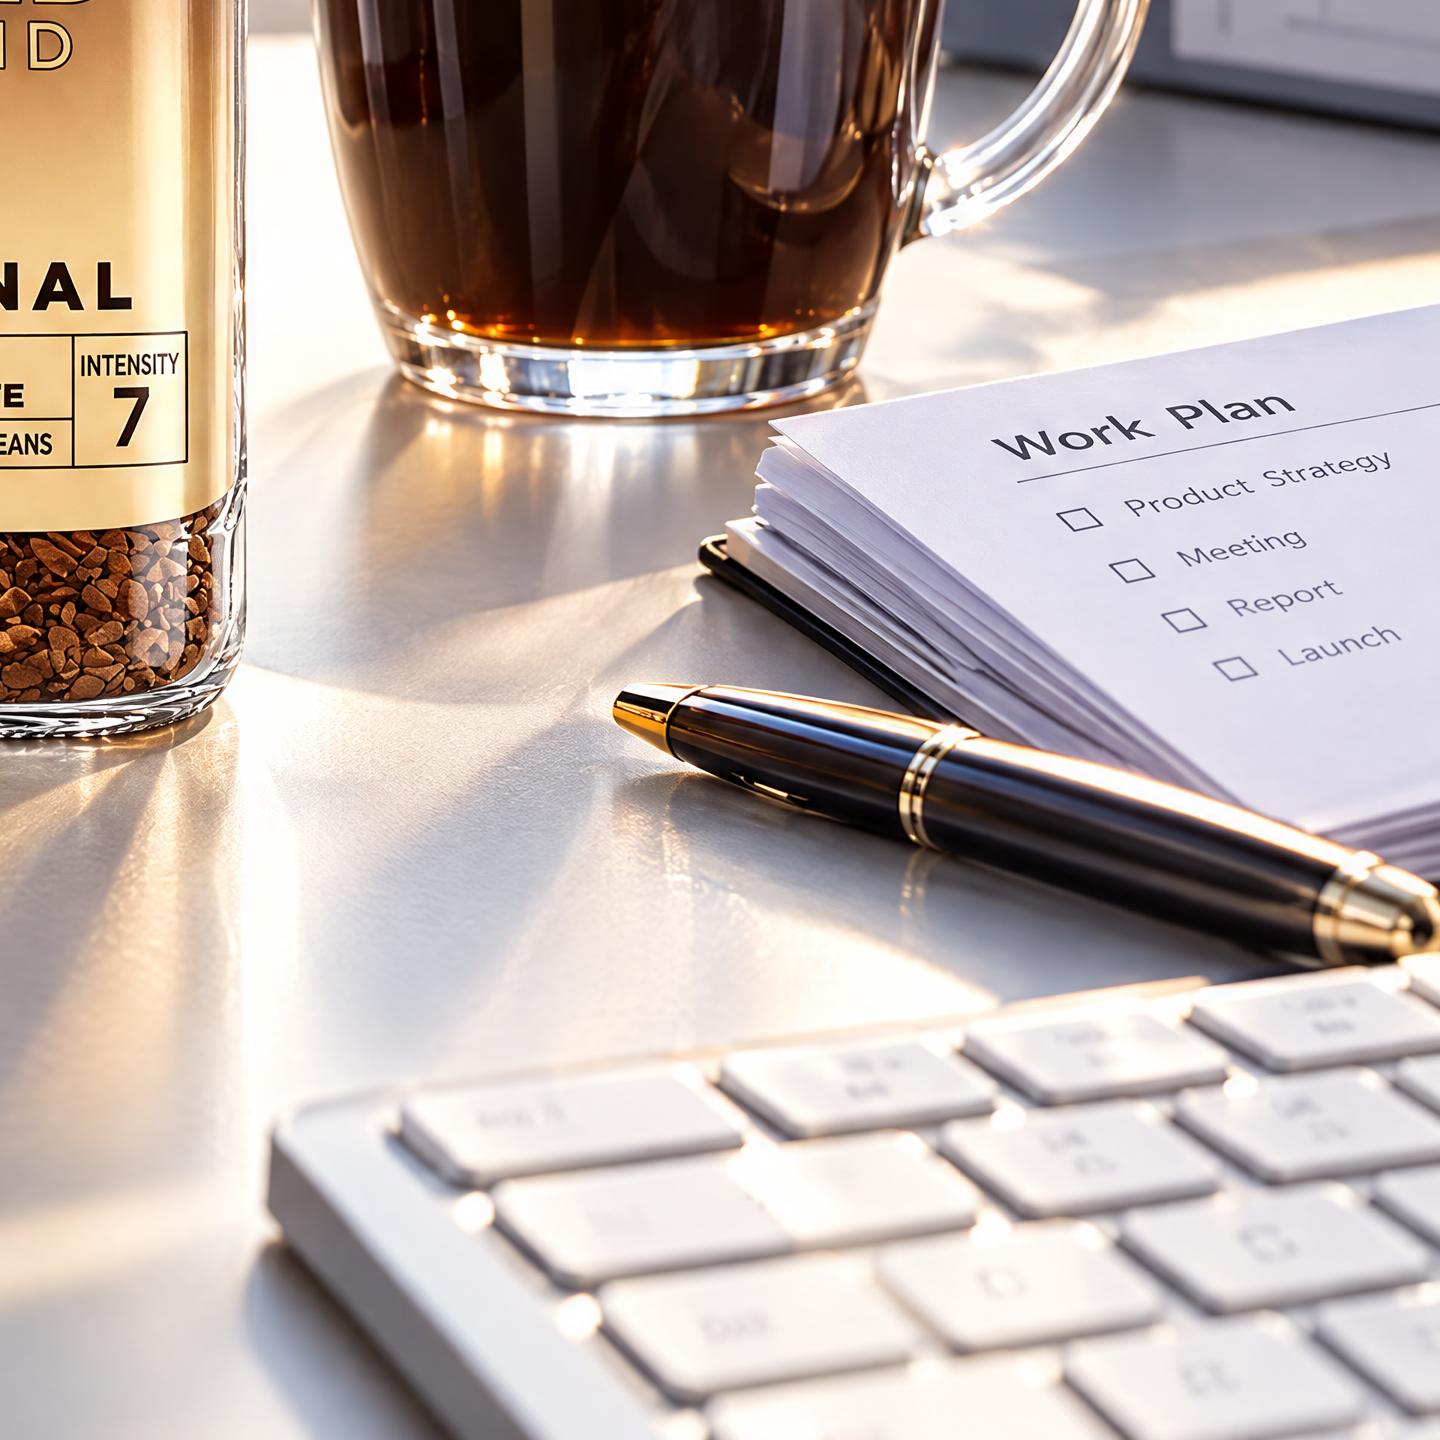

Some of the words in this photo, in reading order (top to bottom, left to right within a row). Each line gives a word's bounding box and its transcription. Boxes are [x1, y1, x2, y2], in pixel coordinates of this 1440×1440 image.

[80, 353, 179, 377] INTENSITY
[113, 386, 150, 448] 7
[991, 415, 1155, 461] Work
[1165, 391, 1296, 430] Plan
[1124, 478, 1256, 518] Product
[1262, 448, 1393, 490] Strategy
[1176, 527, 1308, 568] Meeting
[1226, 579, 1344, 617] Report
[1277, 624, 1402, 666] Launch
